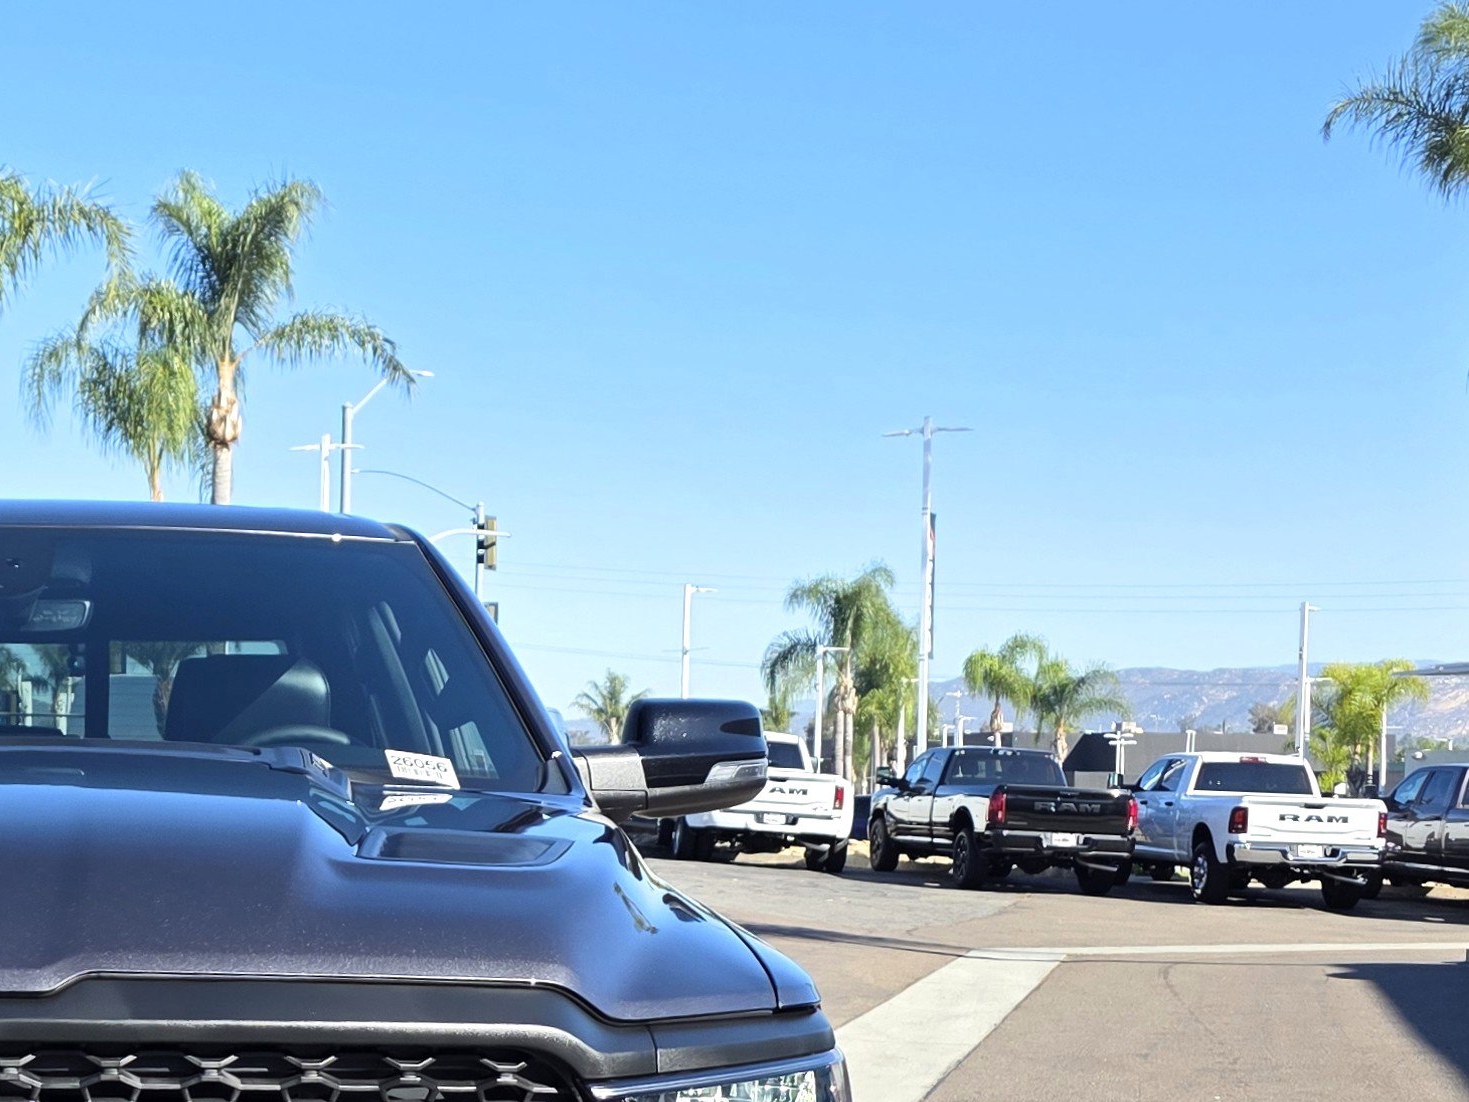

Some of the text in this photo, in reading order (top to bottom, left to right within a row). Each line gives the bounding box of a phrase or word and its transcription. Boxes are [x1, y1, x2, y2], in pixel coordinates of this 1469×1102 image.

[391, 755, 448, 773] 26056
[768, 786, 808, 796] AM
[1034, 801, 1101, 813] RAM
[1278, 813, 1349, 824] RAM
